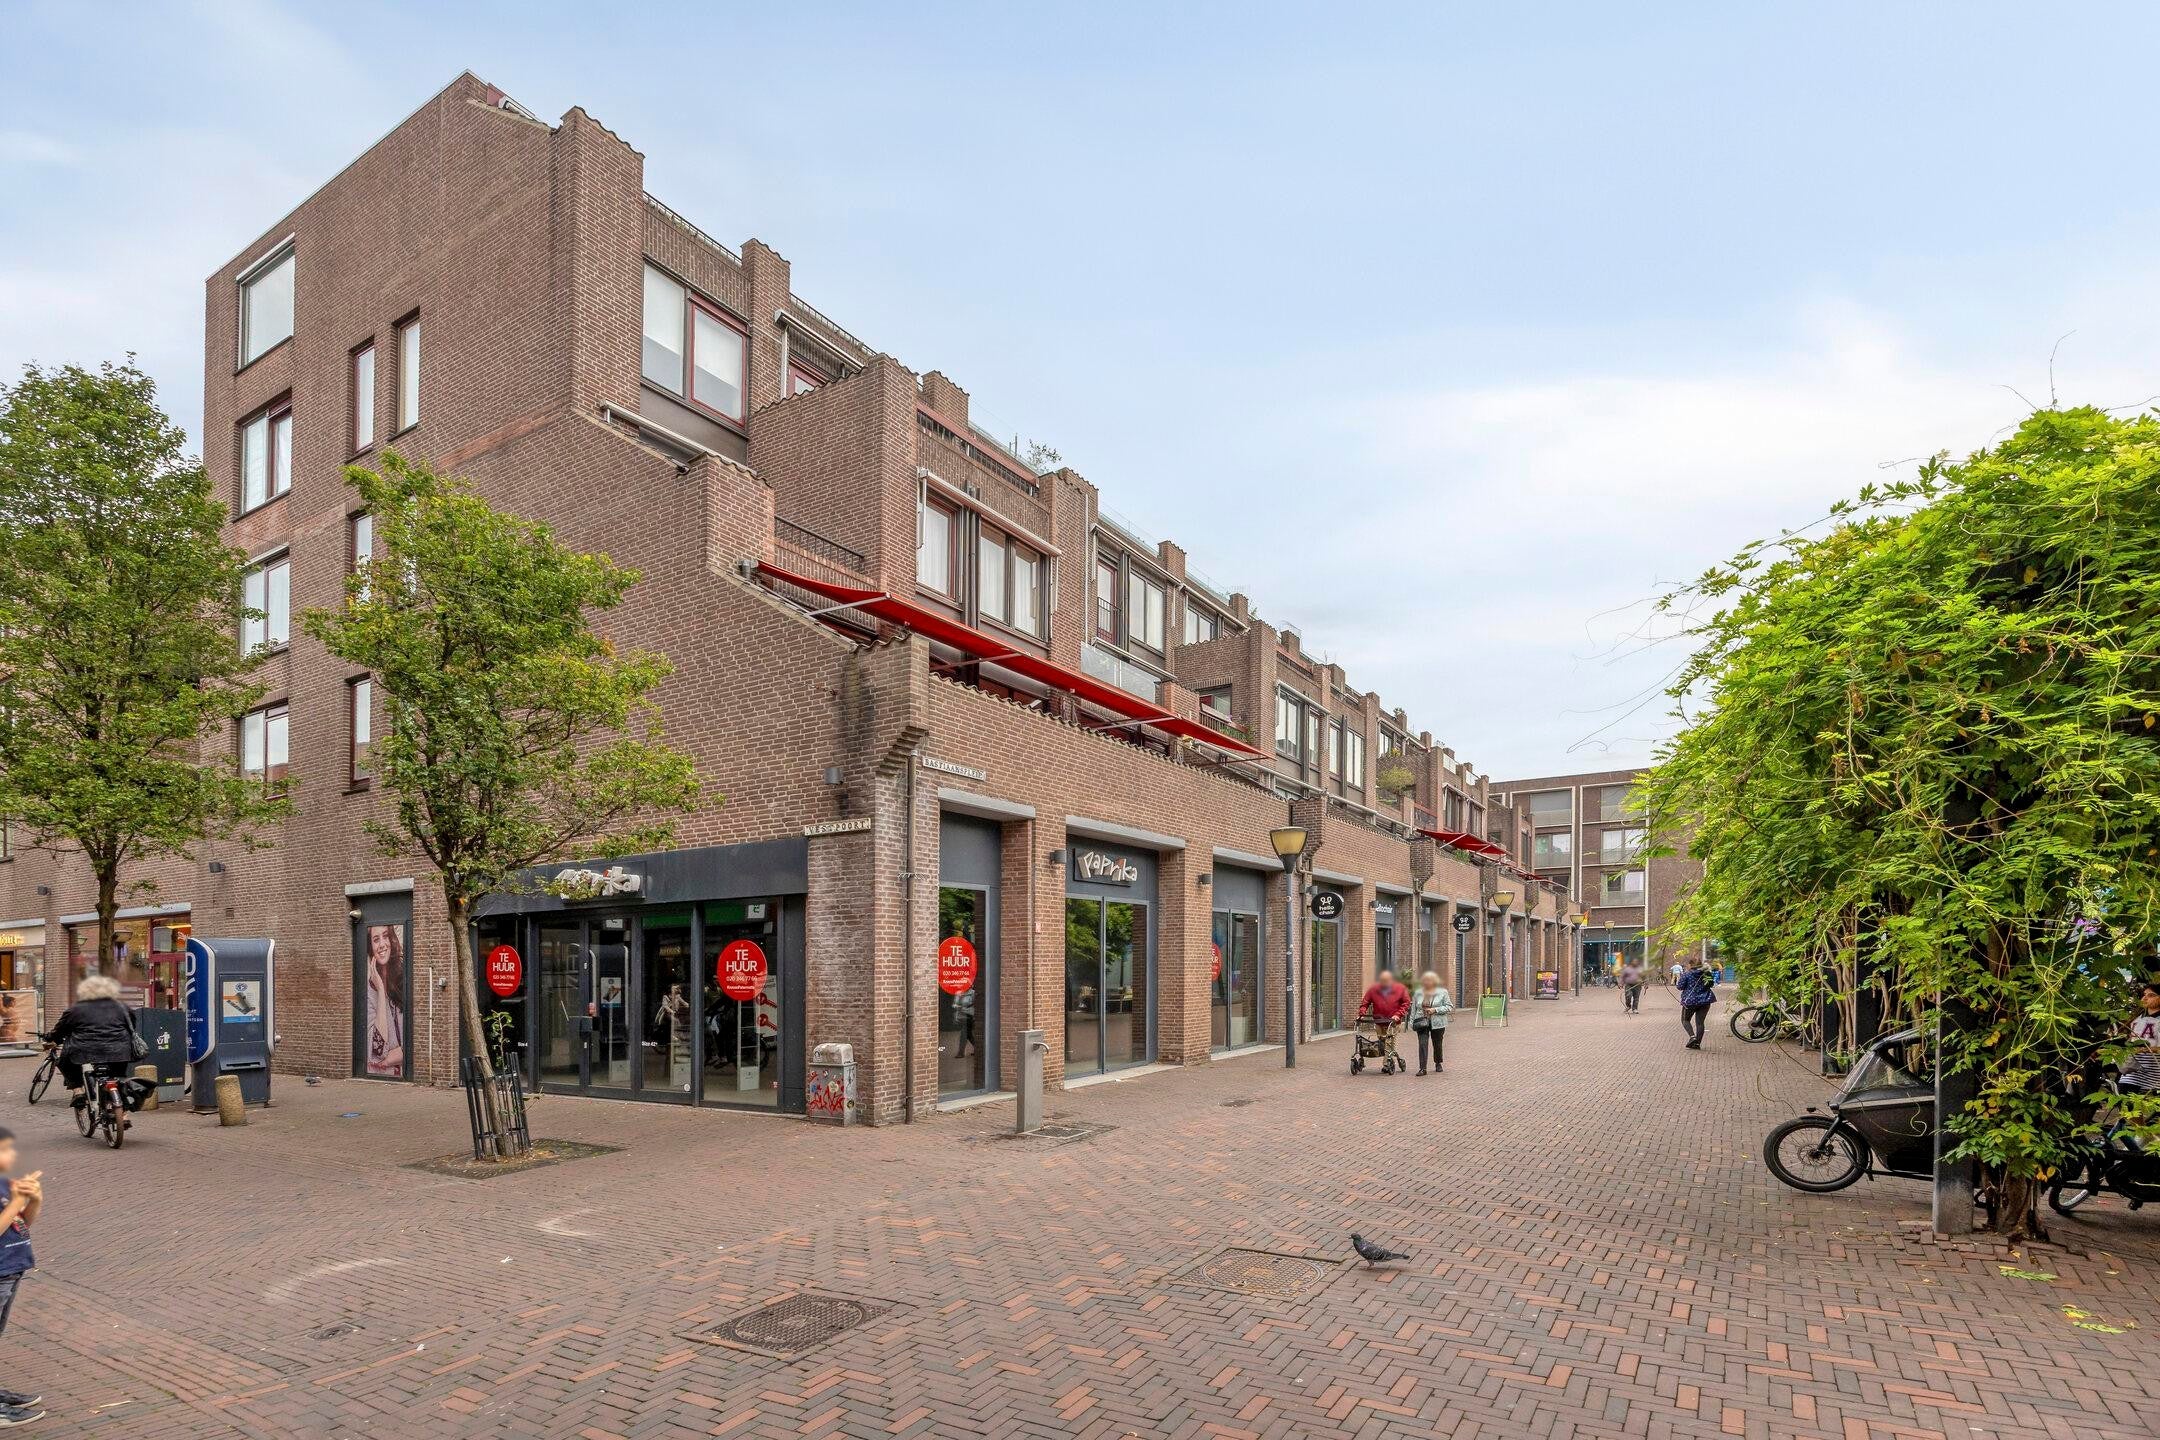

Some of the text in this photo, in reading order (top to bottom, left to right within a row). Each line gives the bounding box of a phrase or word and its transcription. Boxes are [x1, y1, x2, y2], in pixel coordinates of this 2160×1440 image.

[808, 819, 866, 834] VESTPOORT
[735, 949, 749, 961] TE
[950, 945, 963, 956] TE
[499, 952, 510, 962] TE
[942, 956, 970, 967] HUUR
[492, 962, 515, 972] HUUR
[726, 960, 758, 972] HUUR
